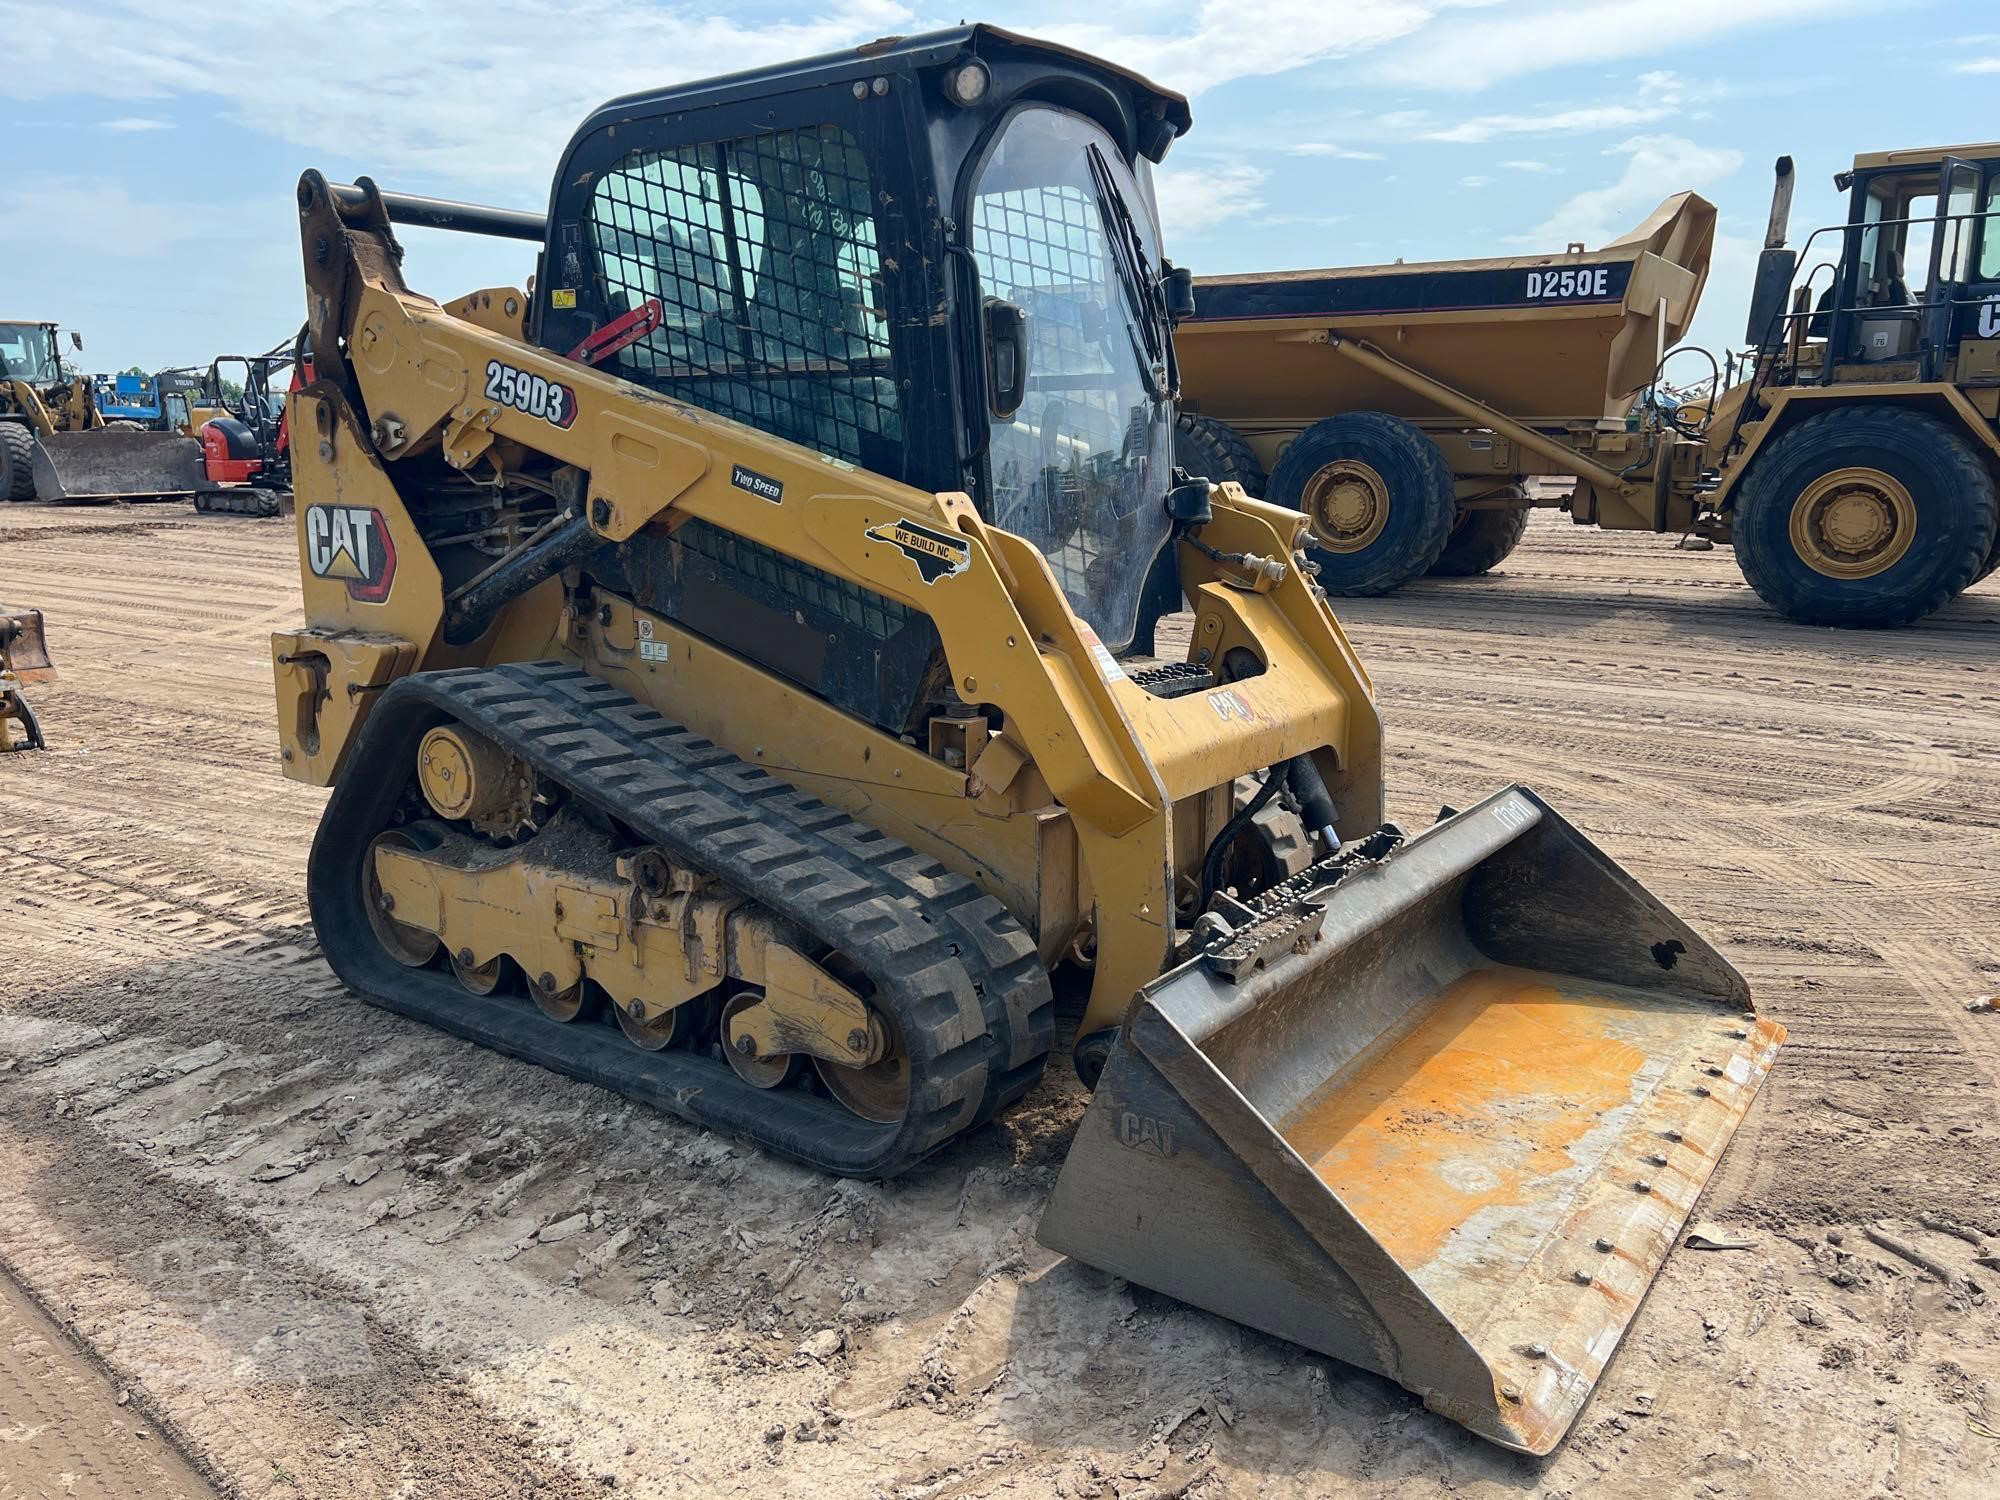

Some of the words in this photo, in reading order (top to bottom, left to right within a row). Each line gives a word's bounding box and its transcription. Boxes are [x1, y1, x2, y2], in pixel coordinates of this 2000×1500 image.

[1526, 269, 1608, 298] D250E
[485, 361, 564, 423] 259D3
[307, 506, 372, 579] CAT
[895, 529, 909, 543] WE
[910, 535, 935, 552] BUILD
[936, 545, 950, 558] NC
[1120, 1112, 1175, 1158] CAT
